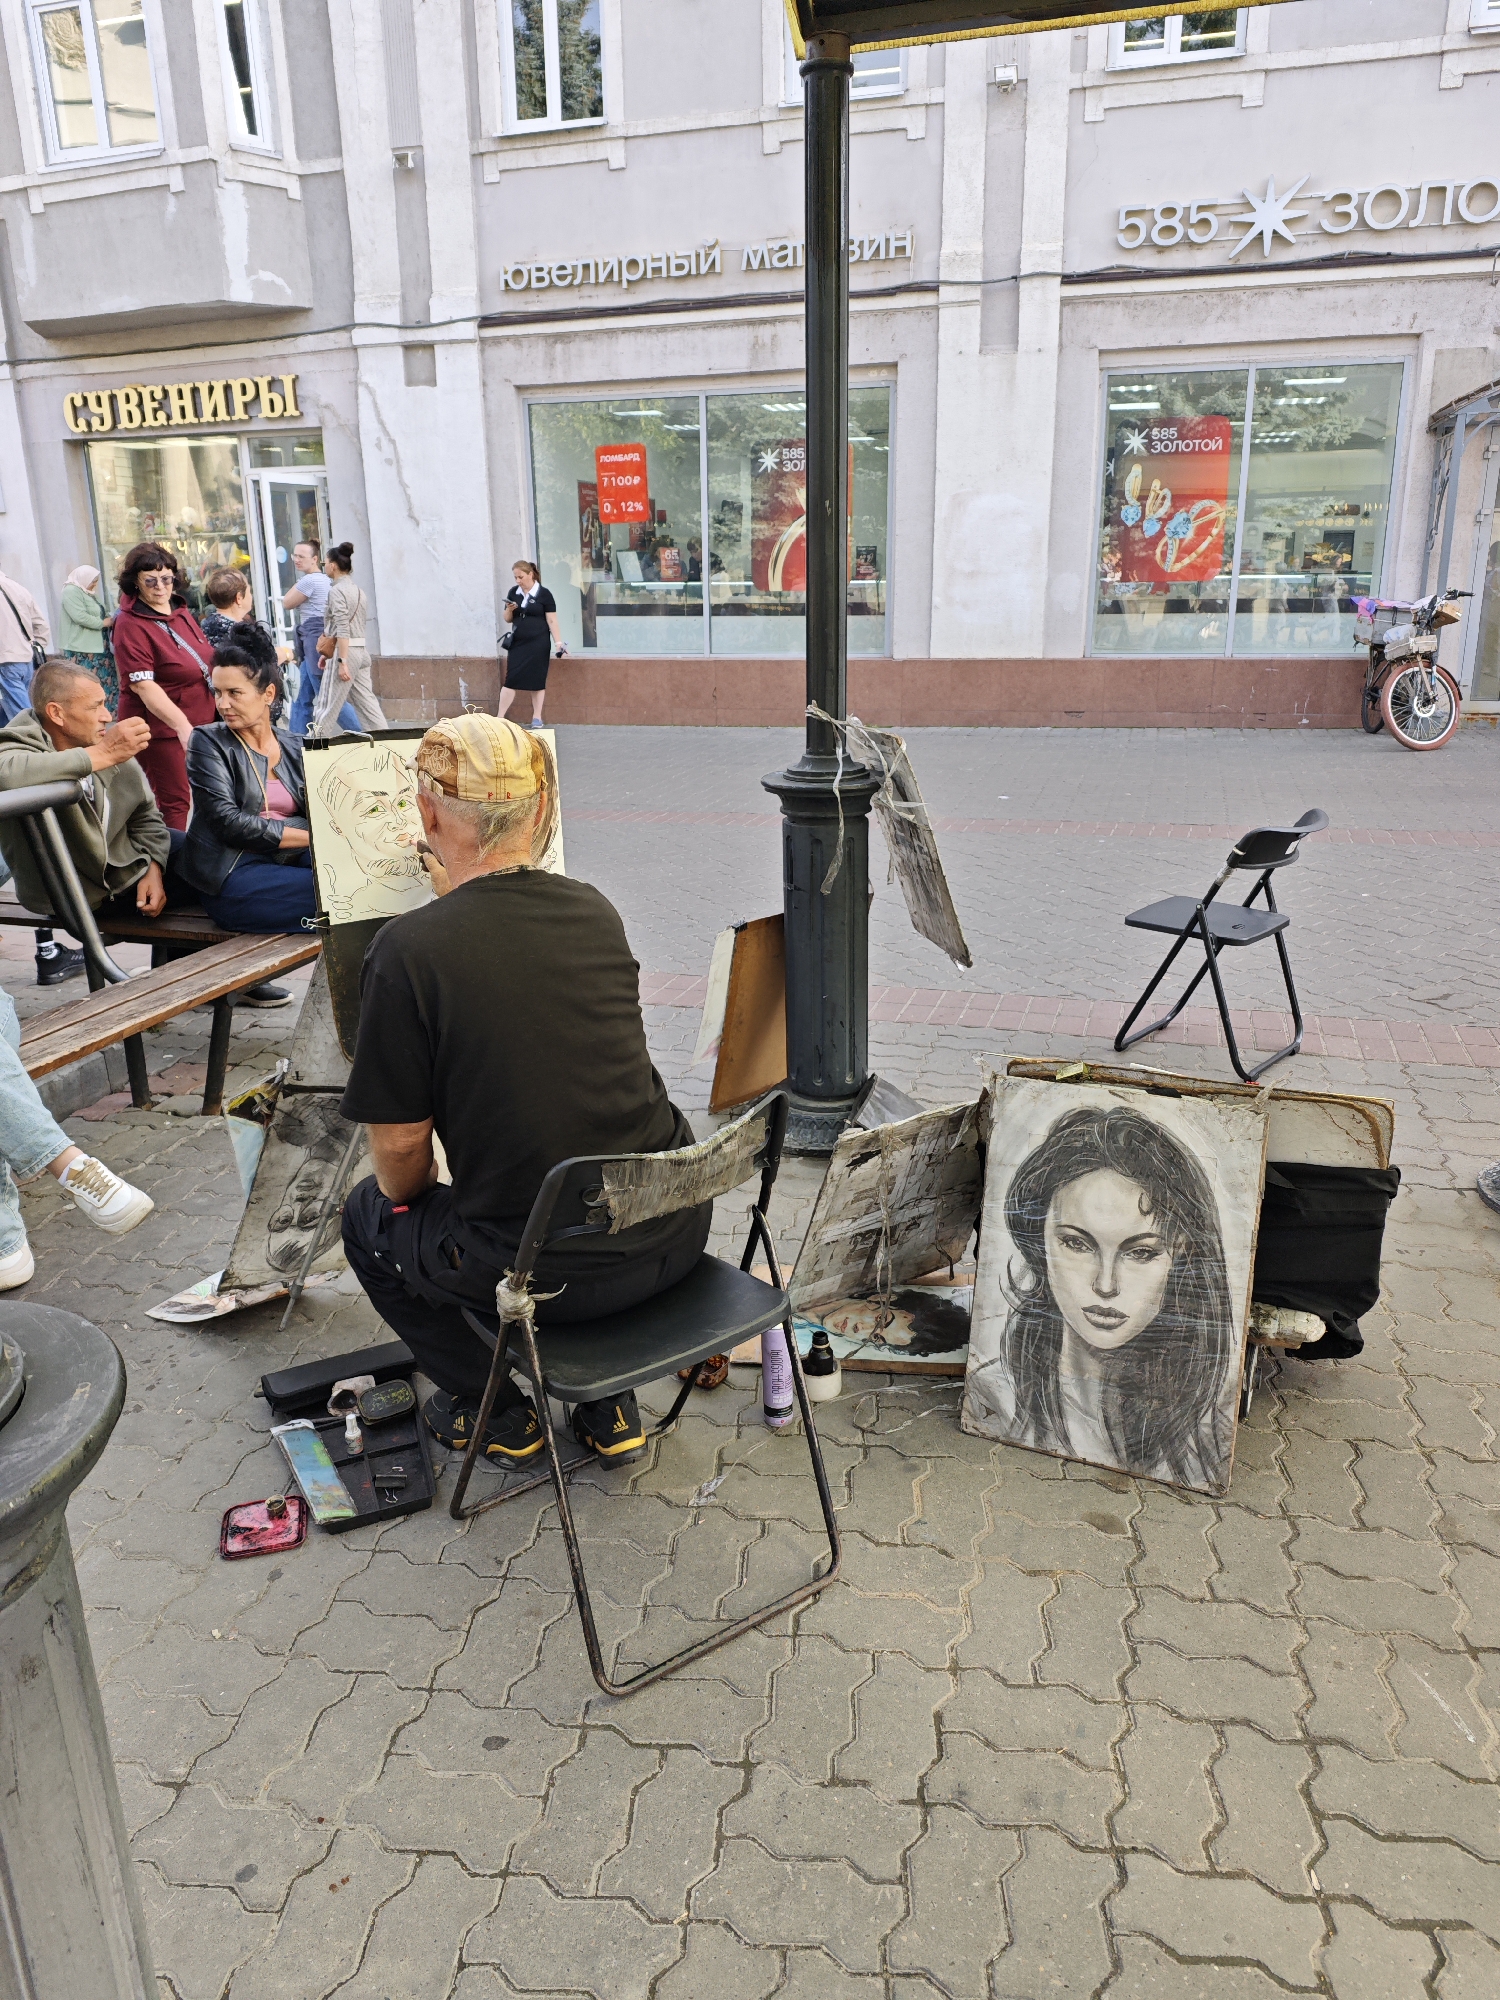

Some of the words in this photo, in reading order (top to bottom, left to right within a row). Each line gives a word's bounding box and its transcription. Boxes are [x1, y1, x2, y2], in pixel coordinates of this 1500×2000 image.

[1117, 198, 1219, 249] 585
[500, 238, 722, 291] ювелирный
[741, 230, 911, 271] магзин
[63, 374, 303, 433] СУВЕНИРЫ
[1151, 427, 1178, 440] 585
[782, 447, 805, 459] 585
[1151, 436, 1223, 453] ЗОЛОТОЙ
[600, 452, 641, 463] ЛОМБАРД
